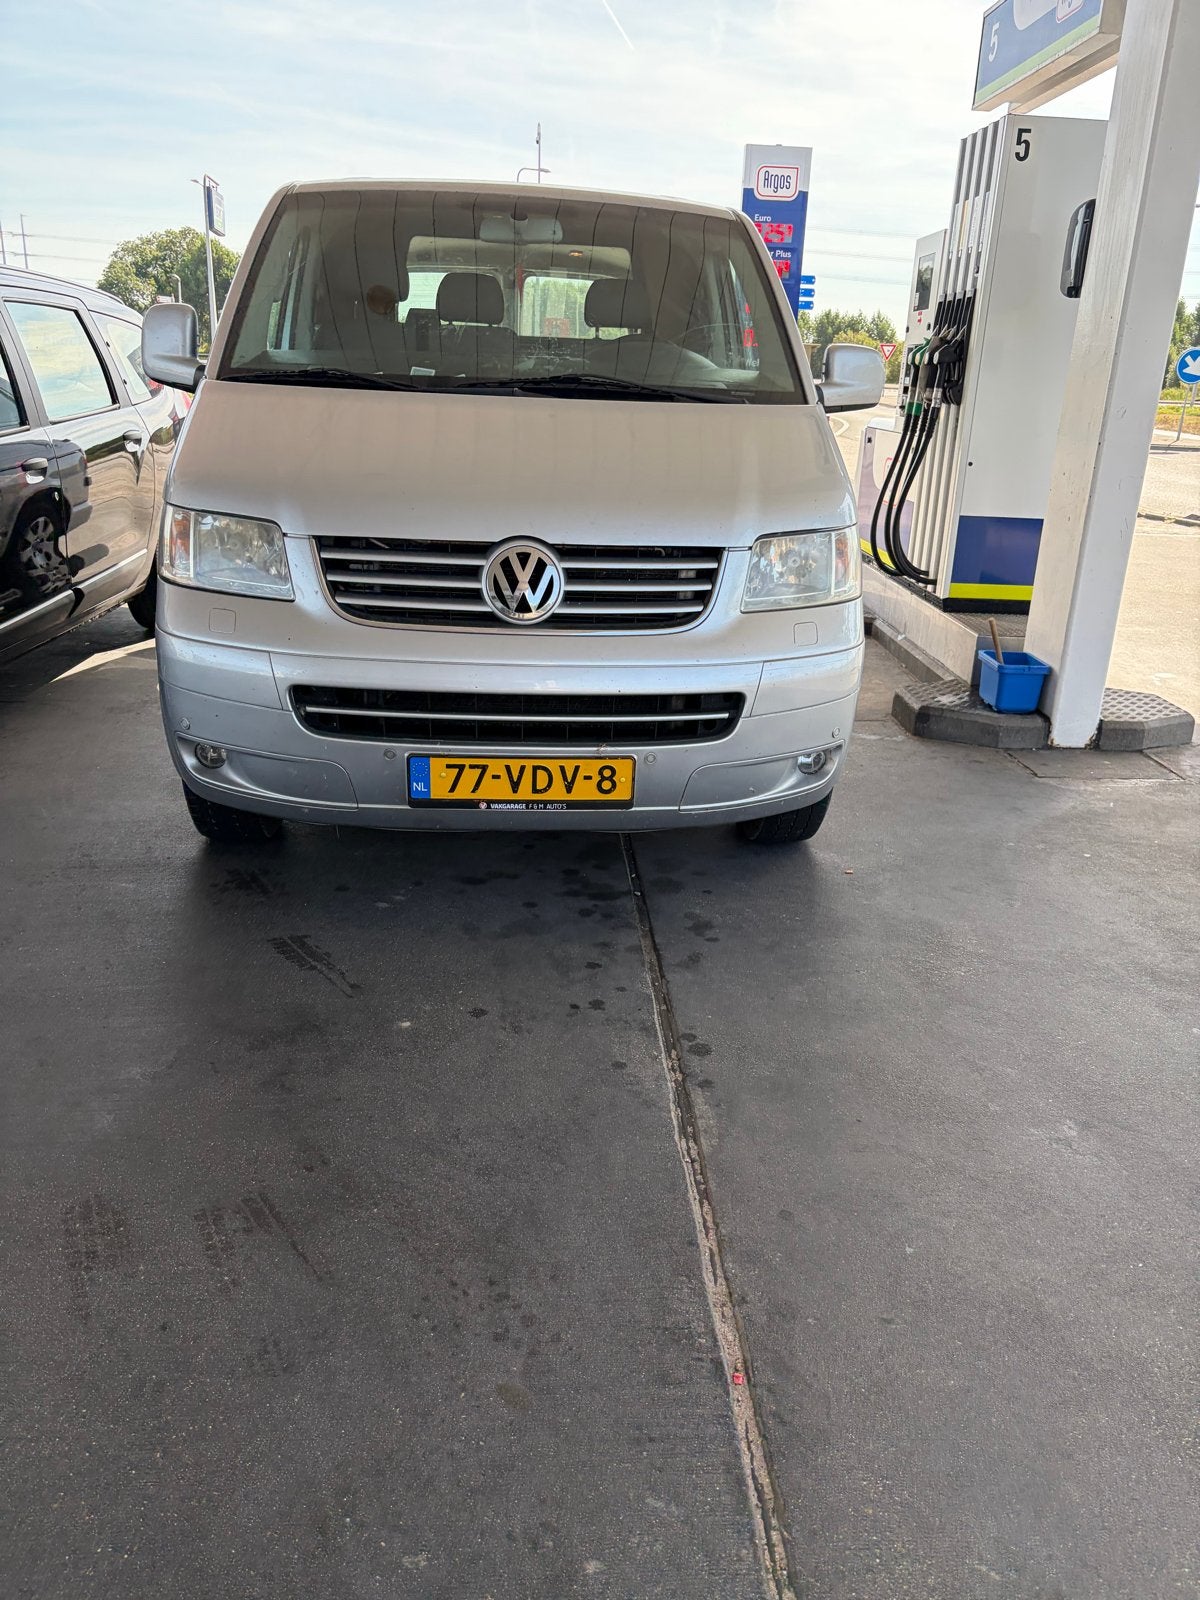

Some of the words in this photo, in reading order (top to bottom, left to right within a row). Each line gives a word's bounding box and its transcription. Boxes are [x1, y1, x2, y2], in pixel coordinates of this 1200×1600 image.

[988, 22, 1000, 62] 5
[1014, 127, 1032, 162] 5
[762, 169, 792, 194] Argos
[754, 213, 772, 222] Euro
[775, 249, 792, 258] Plus
[412, 781, 428, 792] NL
[445, 763, 618, 795] 77-VDV-8
